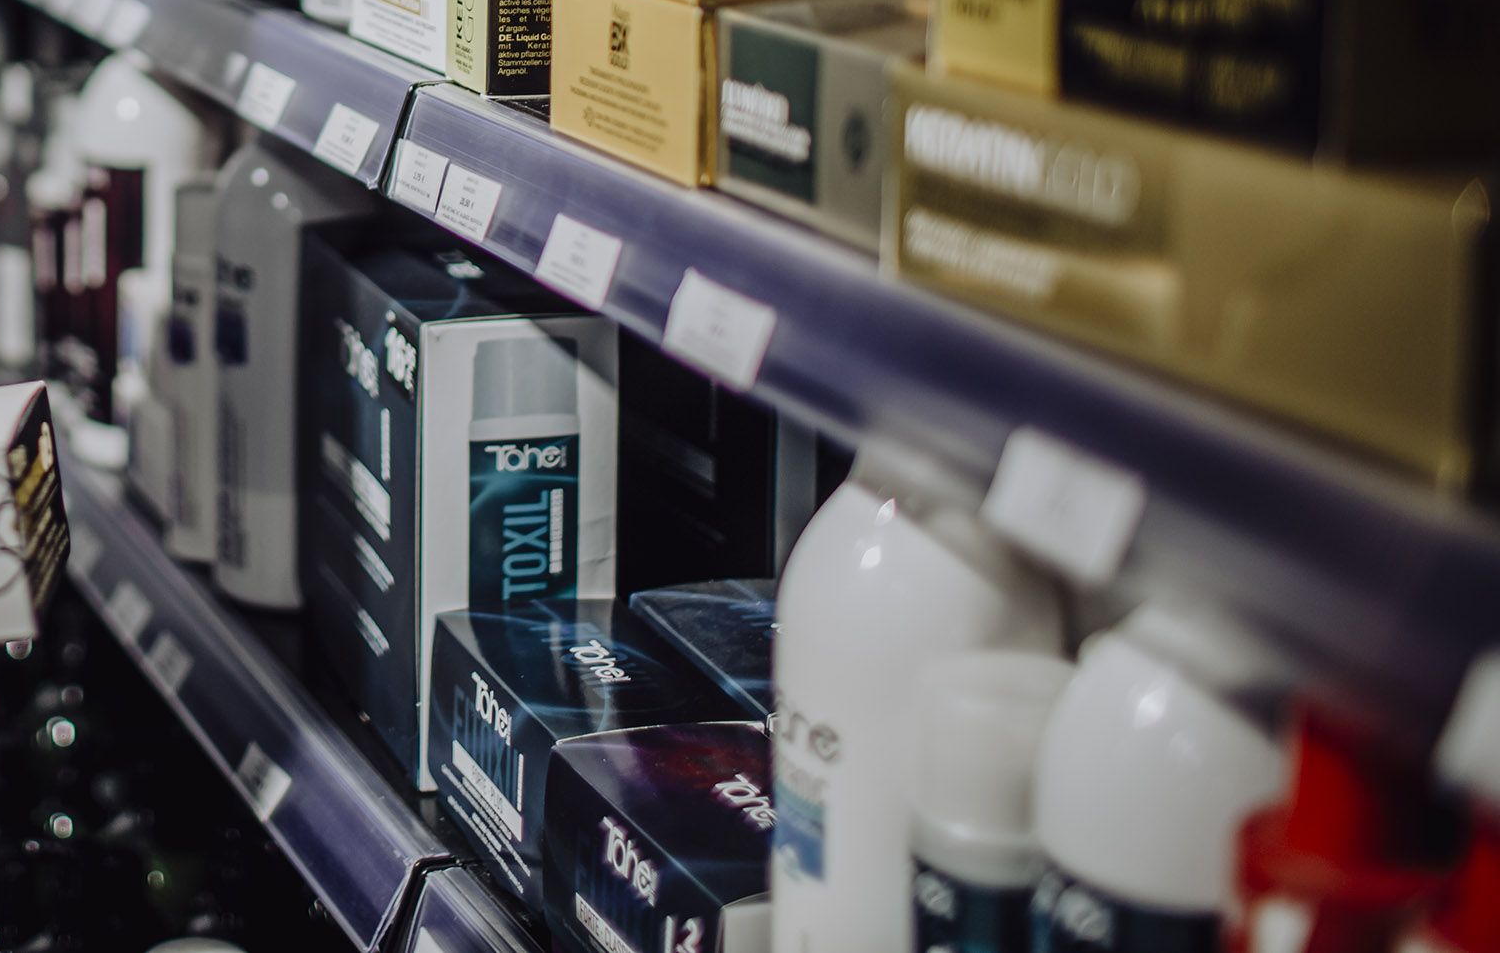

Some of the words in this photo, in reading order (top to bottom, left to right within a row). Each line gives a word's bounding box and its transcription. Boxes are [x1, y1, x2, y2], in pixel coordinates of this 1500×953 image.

[498, 15, 511, 23] les
[519, 15, 527, 23] et
[499, 7, 530, 15] souches
[499, 34, 515, 42] DE.
[516, 33, 540, 42] Liquid
[498, 58, 543, 67] Stammzellen
[484, 444, 562, 472] Tahe
[502, 490, 549, 600] TOXIL
[569, 639, 628, 681] Tahe
[471, 671, 510, 742] Tahe
[601, 816, 654, 899] Tahe
